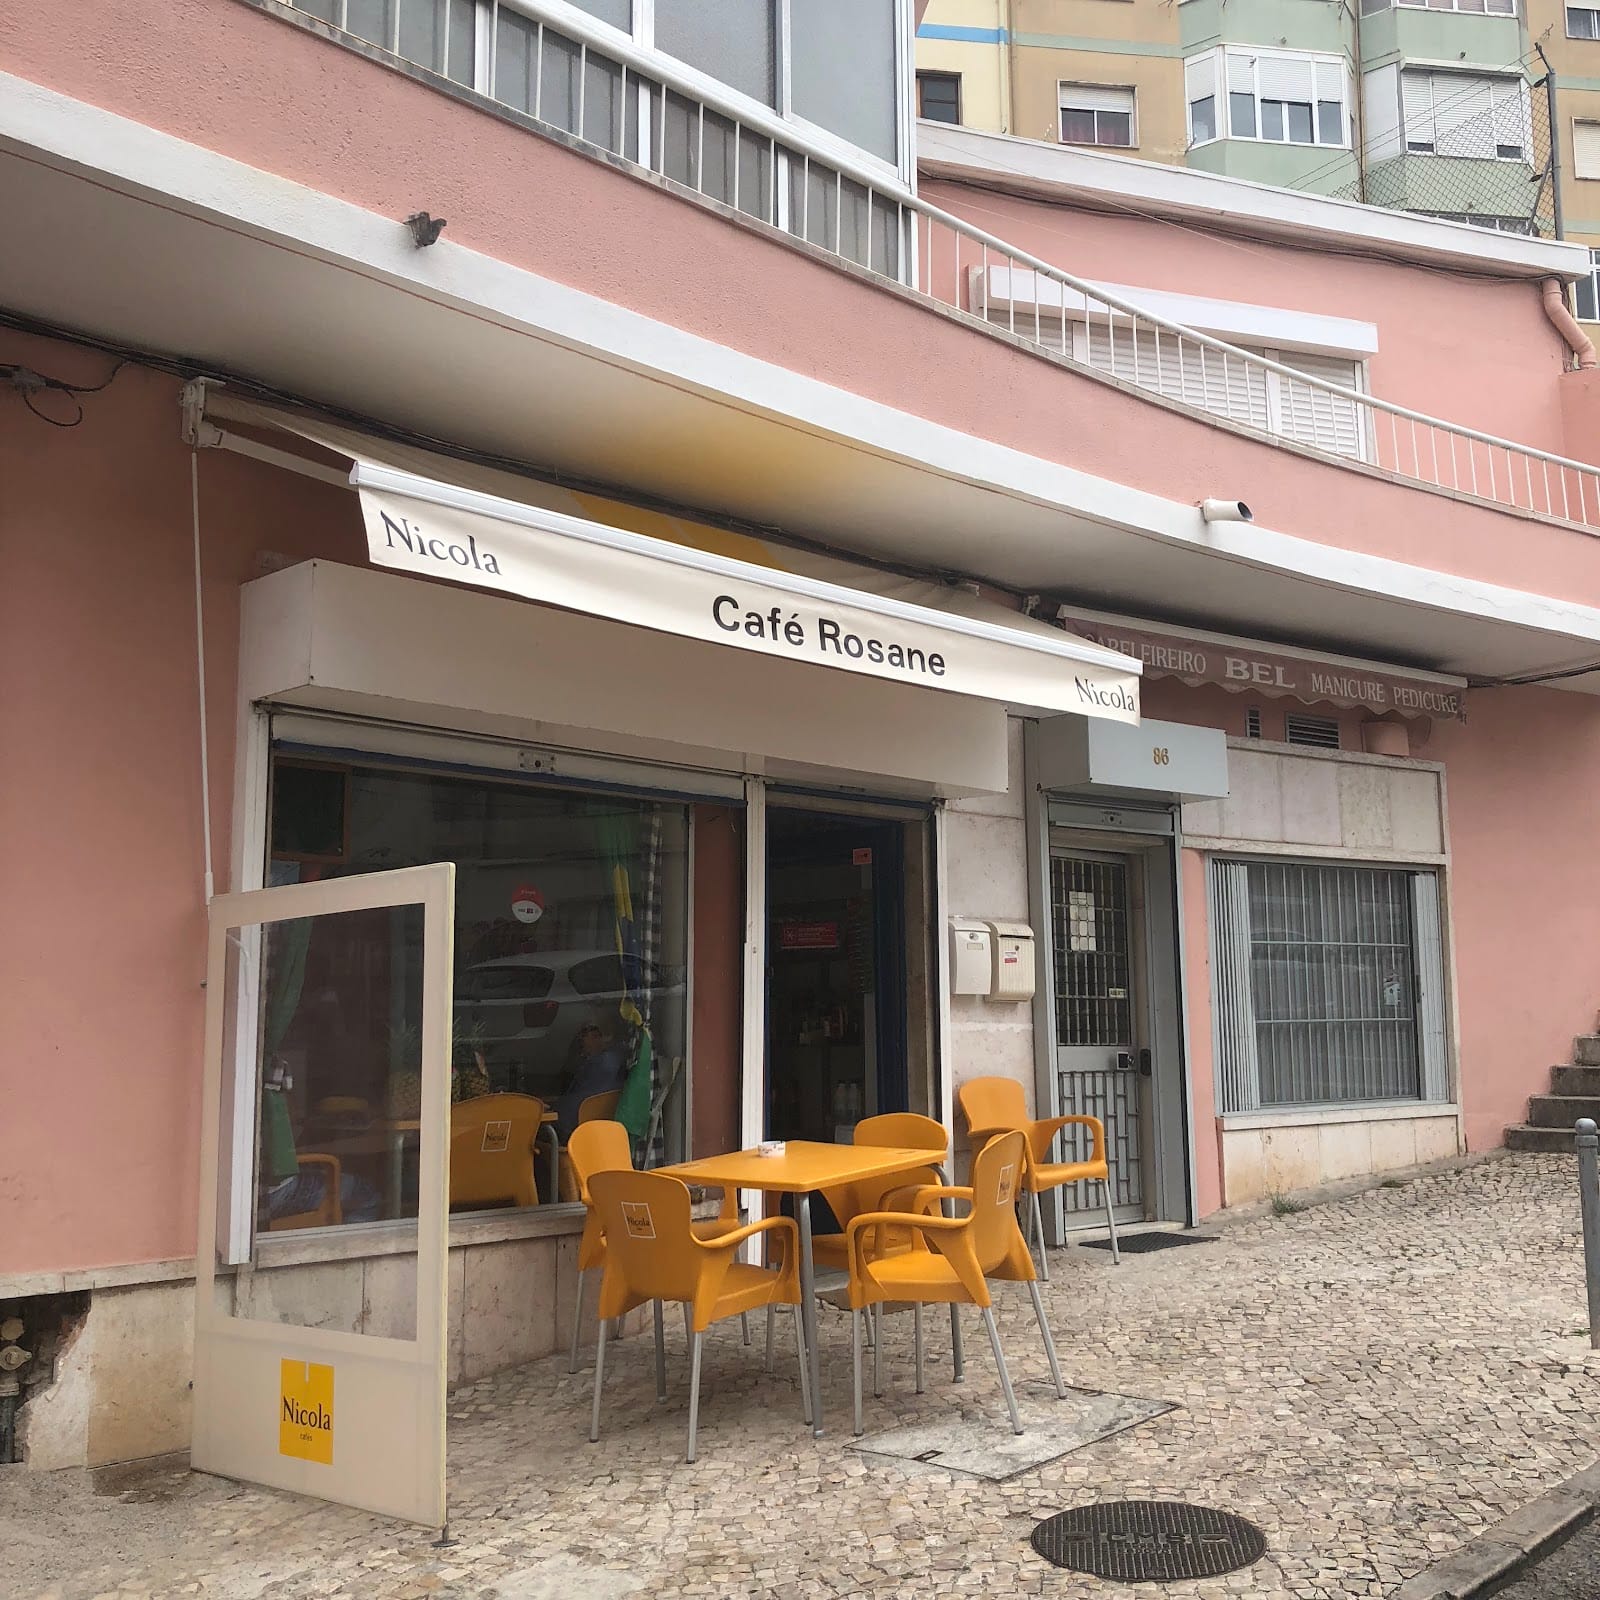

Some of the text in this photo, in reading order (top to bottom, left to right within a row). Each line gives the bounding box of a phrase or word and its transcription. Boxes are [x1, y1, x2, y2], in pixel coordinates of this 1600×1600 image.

[380, 510, 502, 576] Nicola
[712, 595, 946, 676] Café Rosane
[1075, 675, 1136, 712] Nicola
[1224, 656, 1296, 689] BEL
[1311, 672, 1385, 703] MANICURE
[1393, 686, 1458, 715] PEDICURE
[1153, 747, 1170, 765] 86
[626, 1215, 651, 1227] Nicola
[283, 1395, 332, 1431] Nicola
